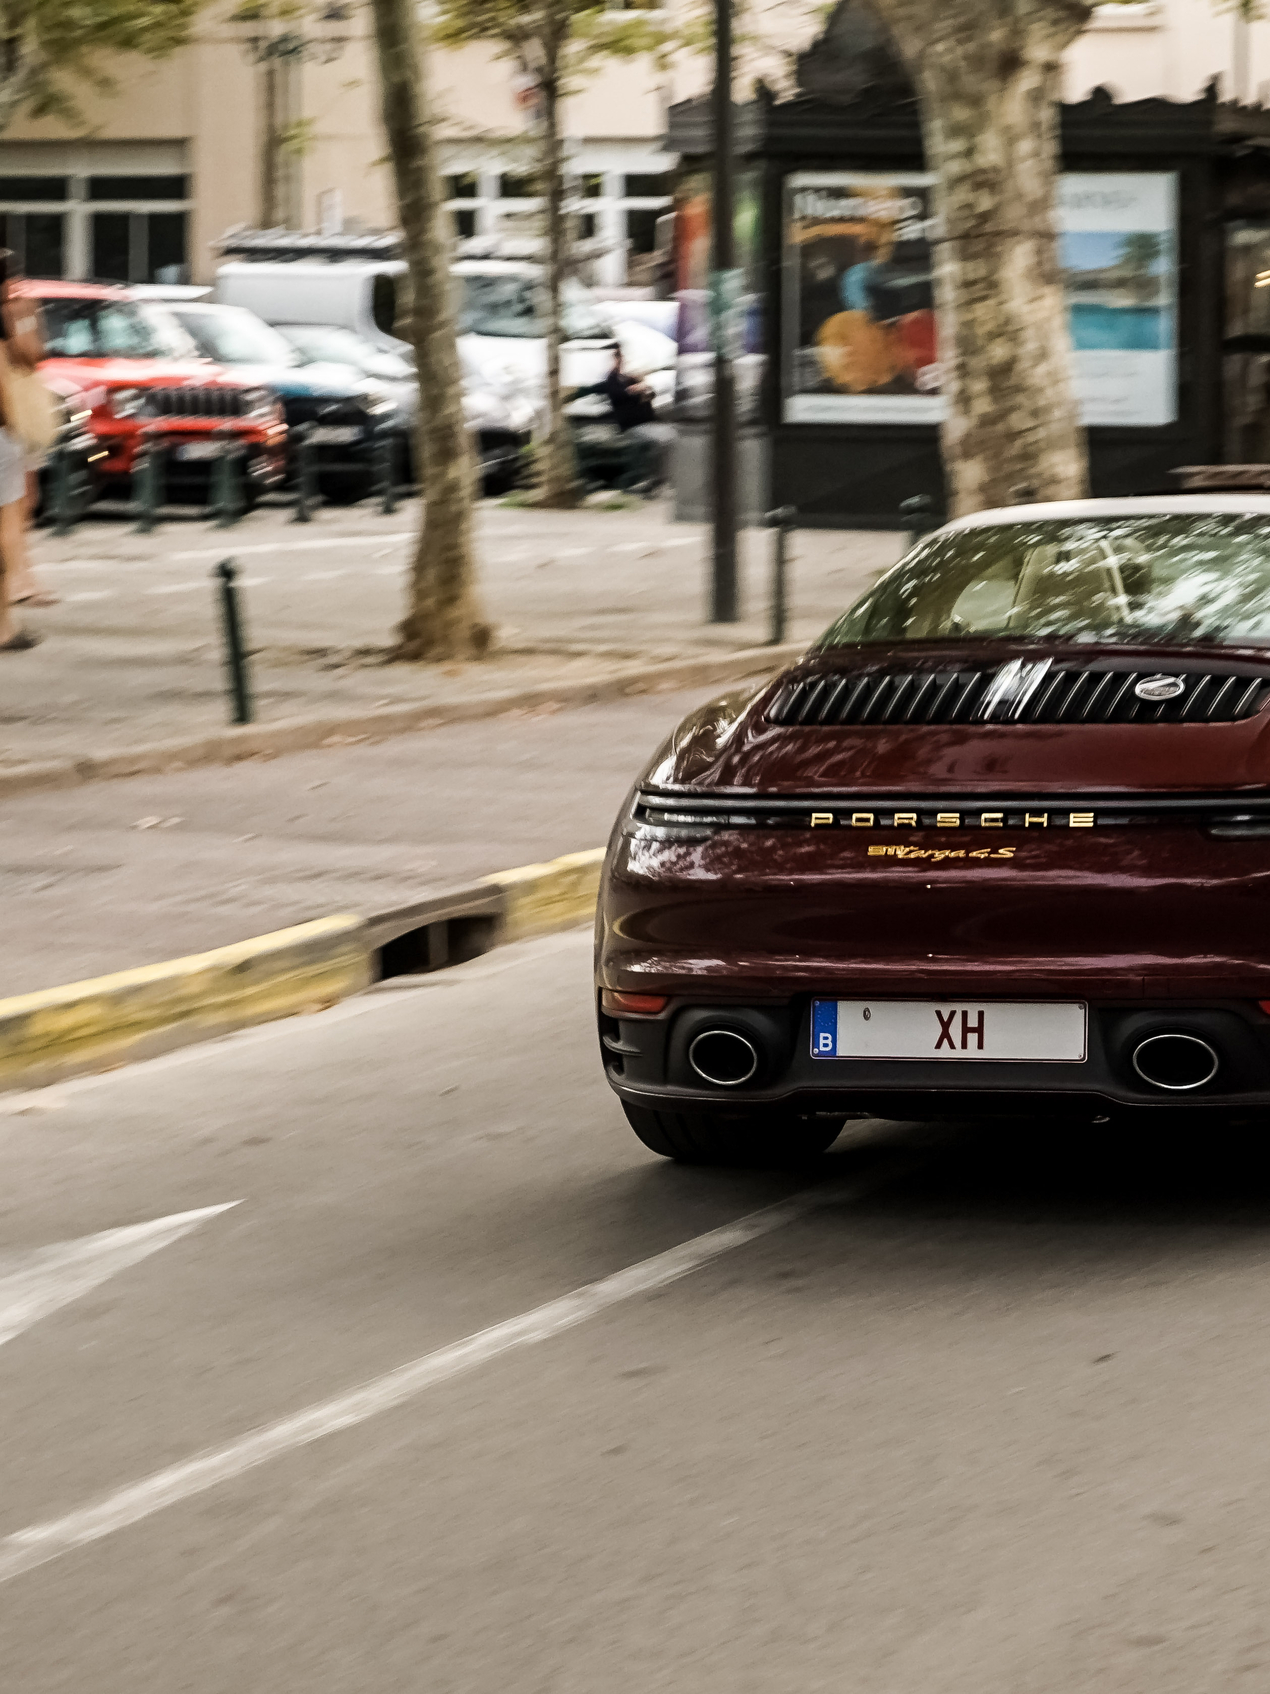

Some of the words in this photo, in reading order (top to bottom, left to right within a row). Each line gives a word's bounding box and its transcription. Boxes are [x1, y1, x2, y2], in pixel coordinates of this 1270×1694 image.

[810, 813, 1094, 828] PORSCHE
[819, 1032, 833, 1051] B
[934, 1009, 985, 1050] XH
